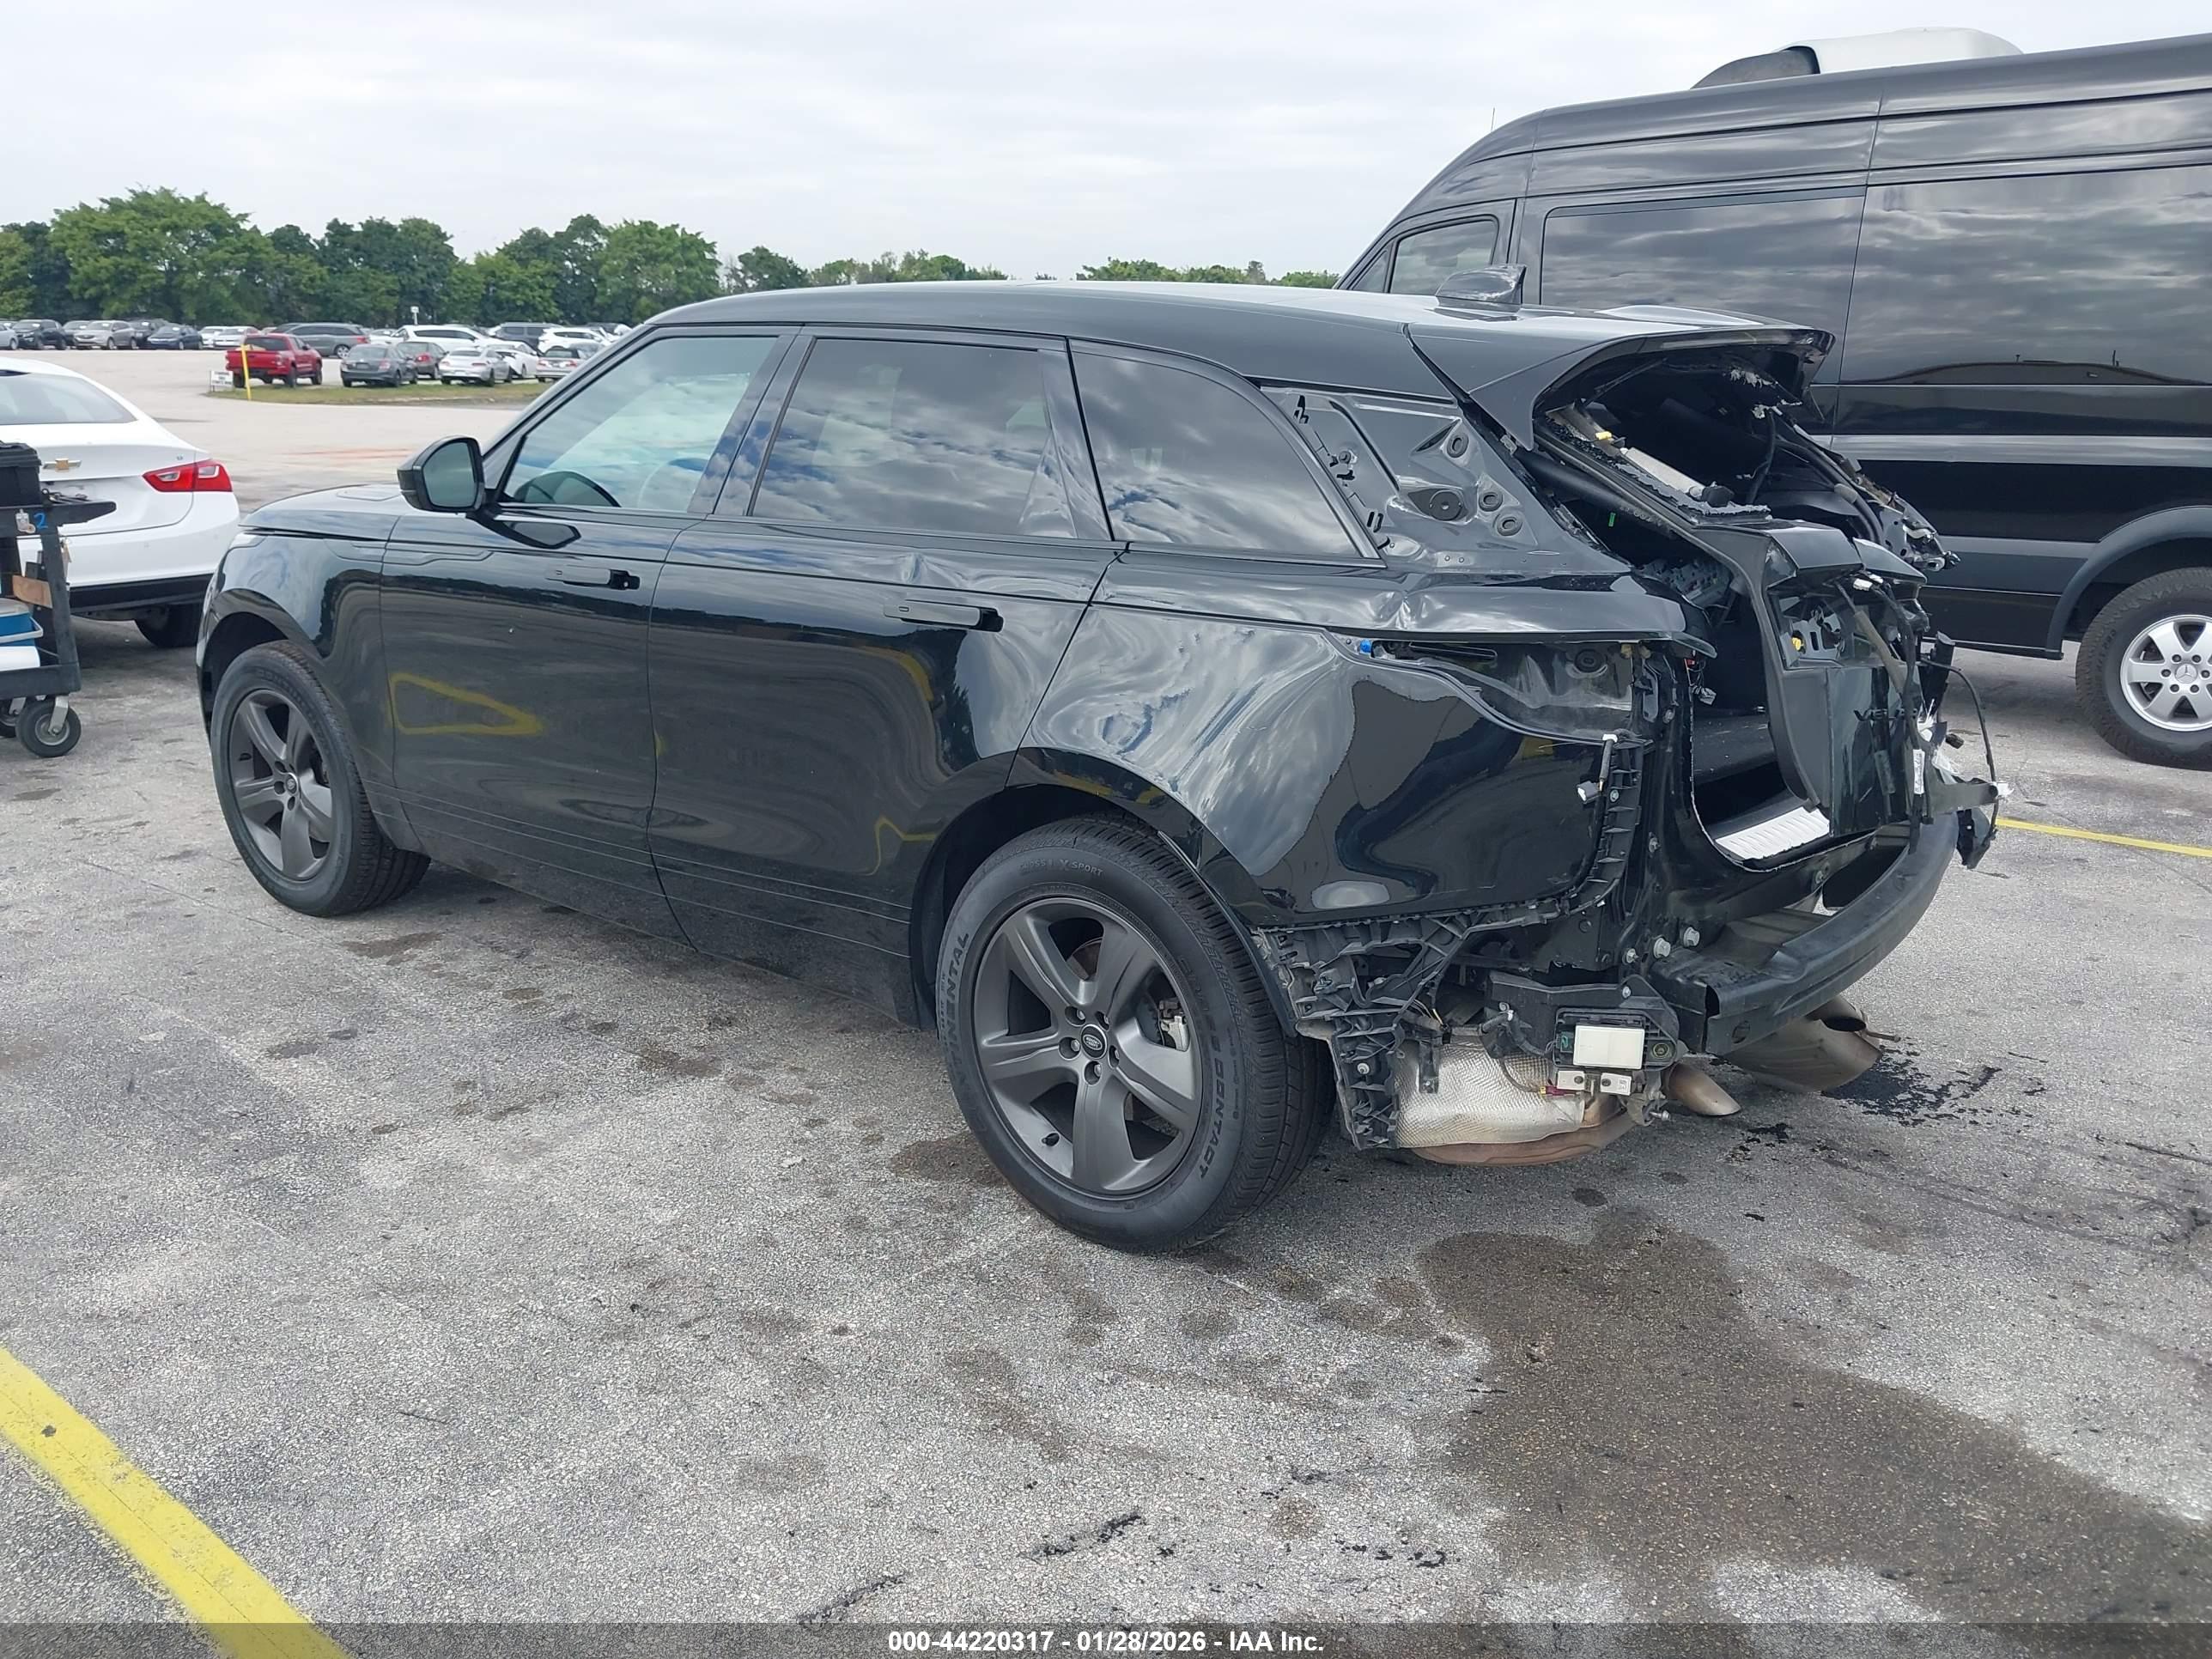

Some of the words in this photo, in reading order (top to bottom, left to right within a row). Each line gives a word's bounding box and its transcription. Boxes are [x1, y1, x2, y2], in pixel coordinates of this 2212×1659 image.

[33, 512, 49, 530] 2
[1071, 860, 1104, 877] SPORT
[1199, 1057, 1225, 1180] CONTACT
